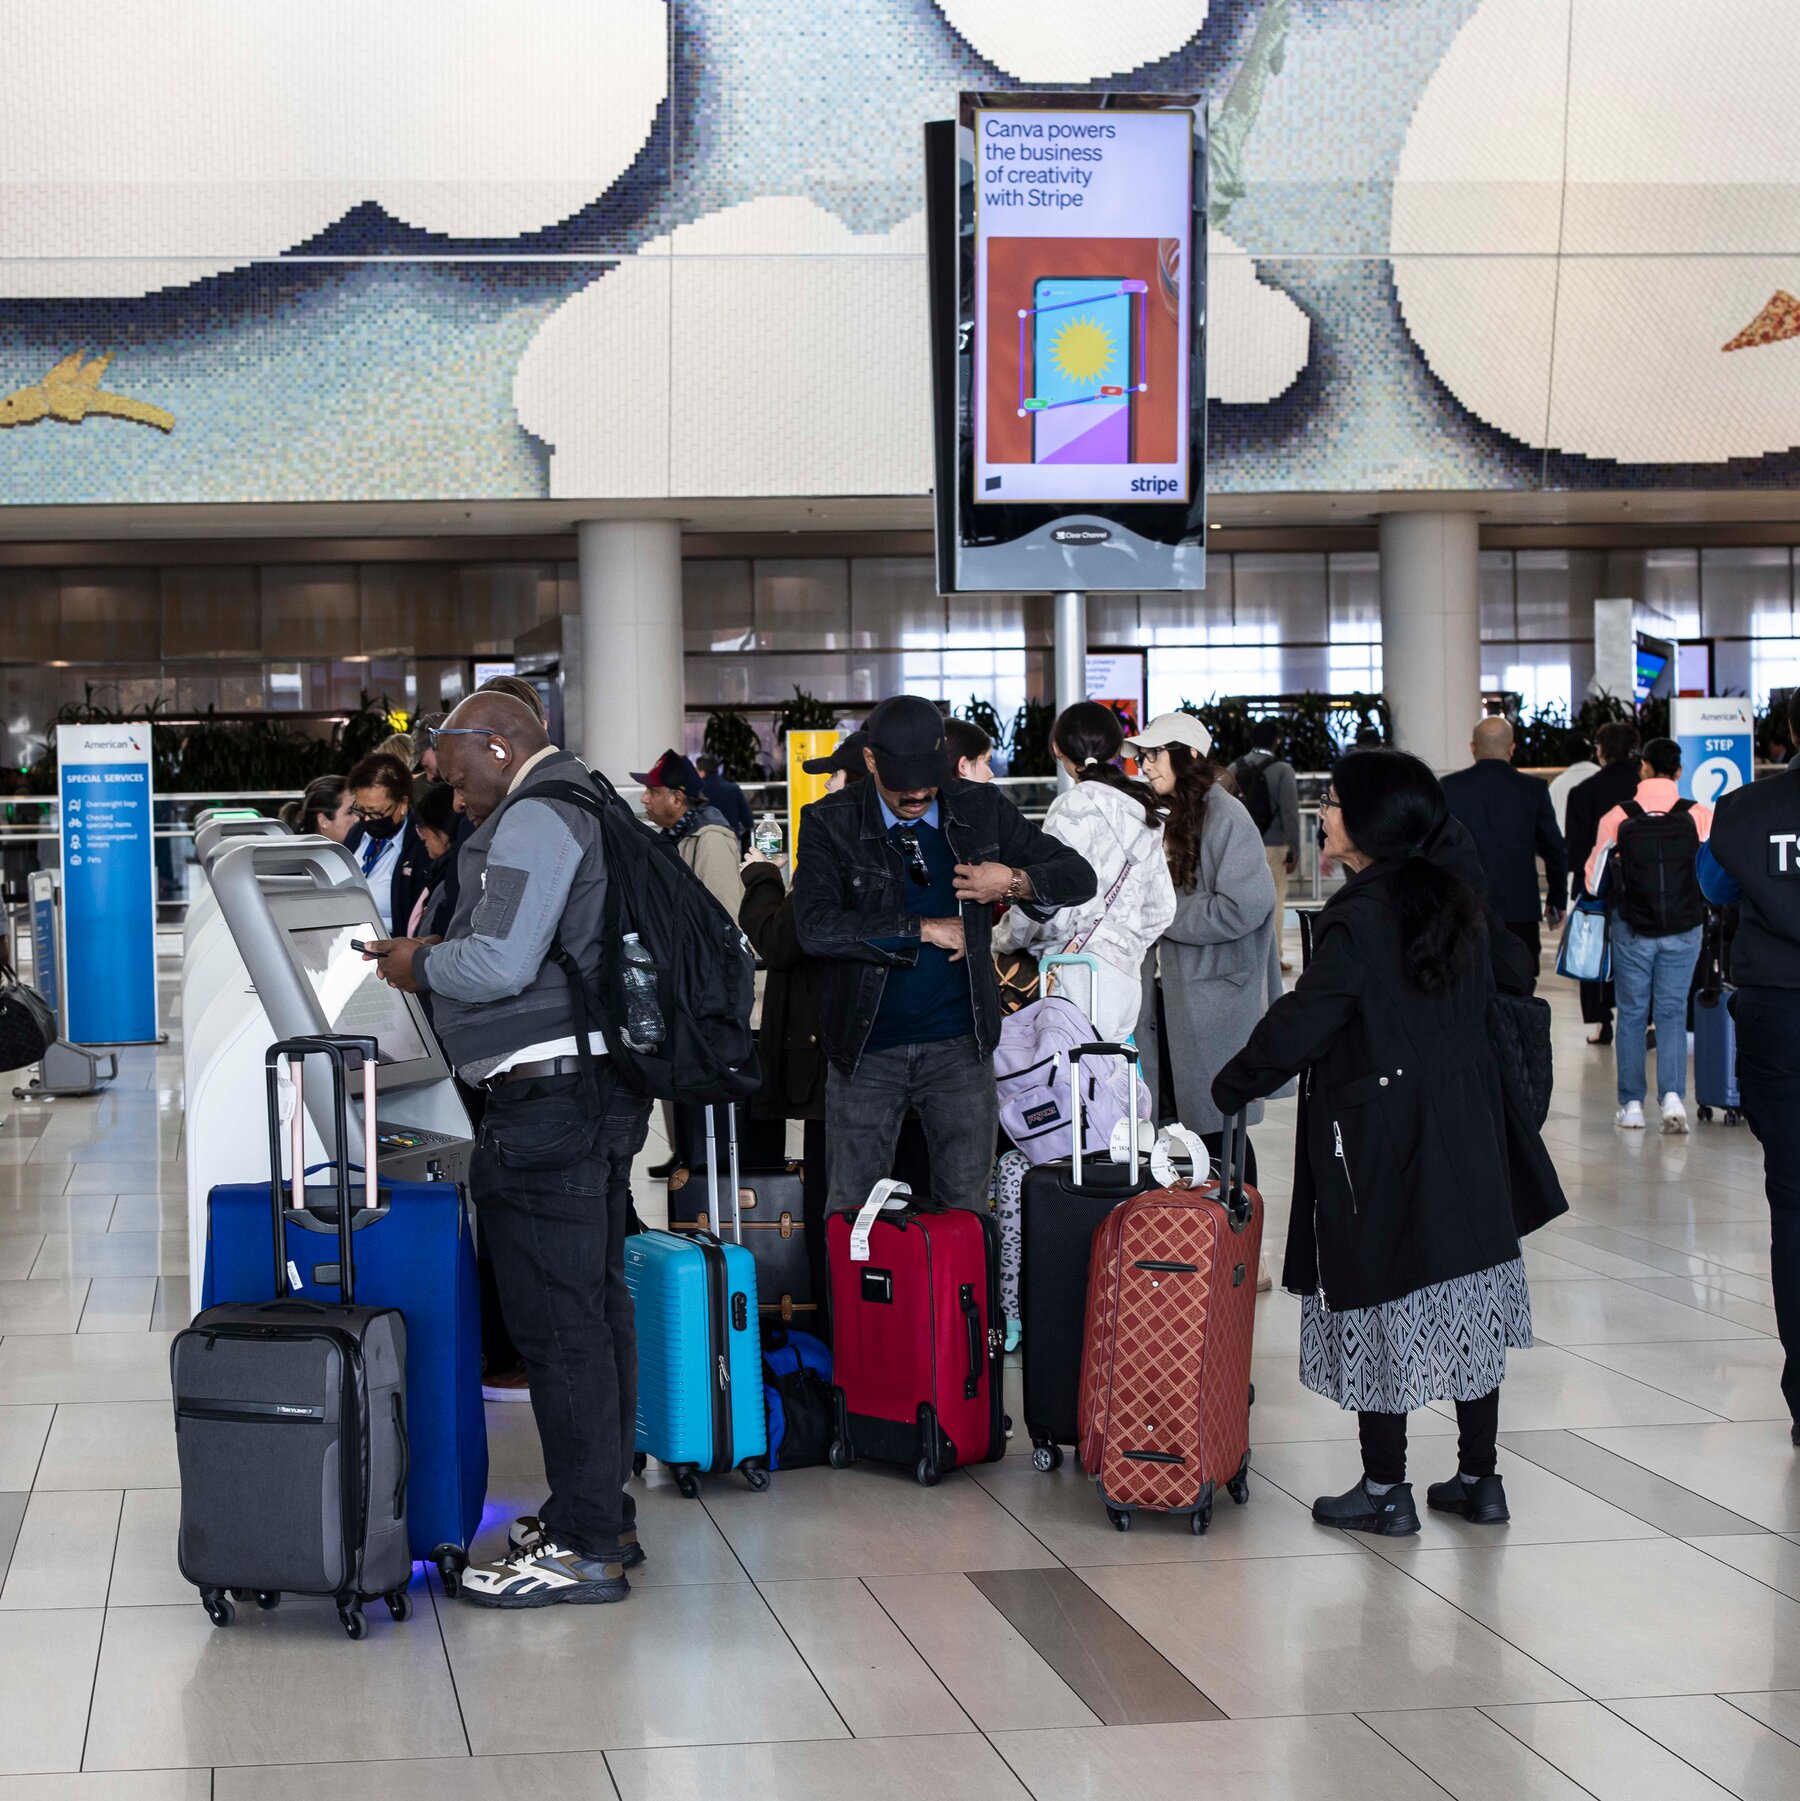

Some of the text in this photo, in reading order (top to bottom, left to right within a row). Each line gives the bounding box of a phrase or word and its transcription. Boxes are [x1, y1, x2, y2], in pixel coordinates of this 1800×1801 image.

[985, 119, 1116, 142] Canva powers
[985, 143, 1103, 161] the business
[985, 166, 1093, 188] of creativity
[985, 188, 1083, 210] with Stripe
[1130, 475, 1178, 495] stripe
[1082, 530, 1107, 539] Channel
[1701, 712, 1738, 721] American
[84, 740, 128, 749] American
[1705, 739, 1734, 751] STEP
[66, 773, 144, 784] SPECIAL SERVICES
[1710, 767, 1729, 803] 2
[85, 800, 122, 809] Overweight
[1769, 834, 1800, 871] T
